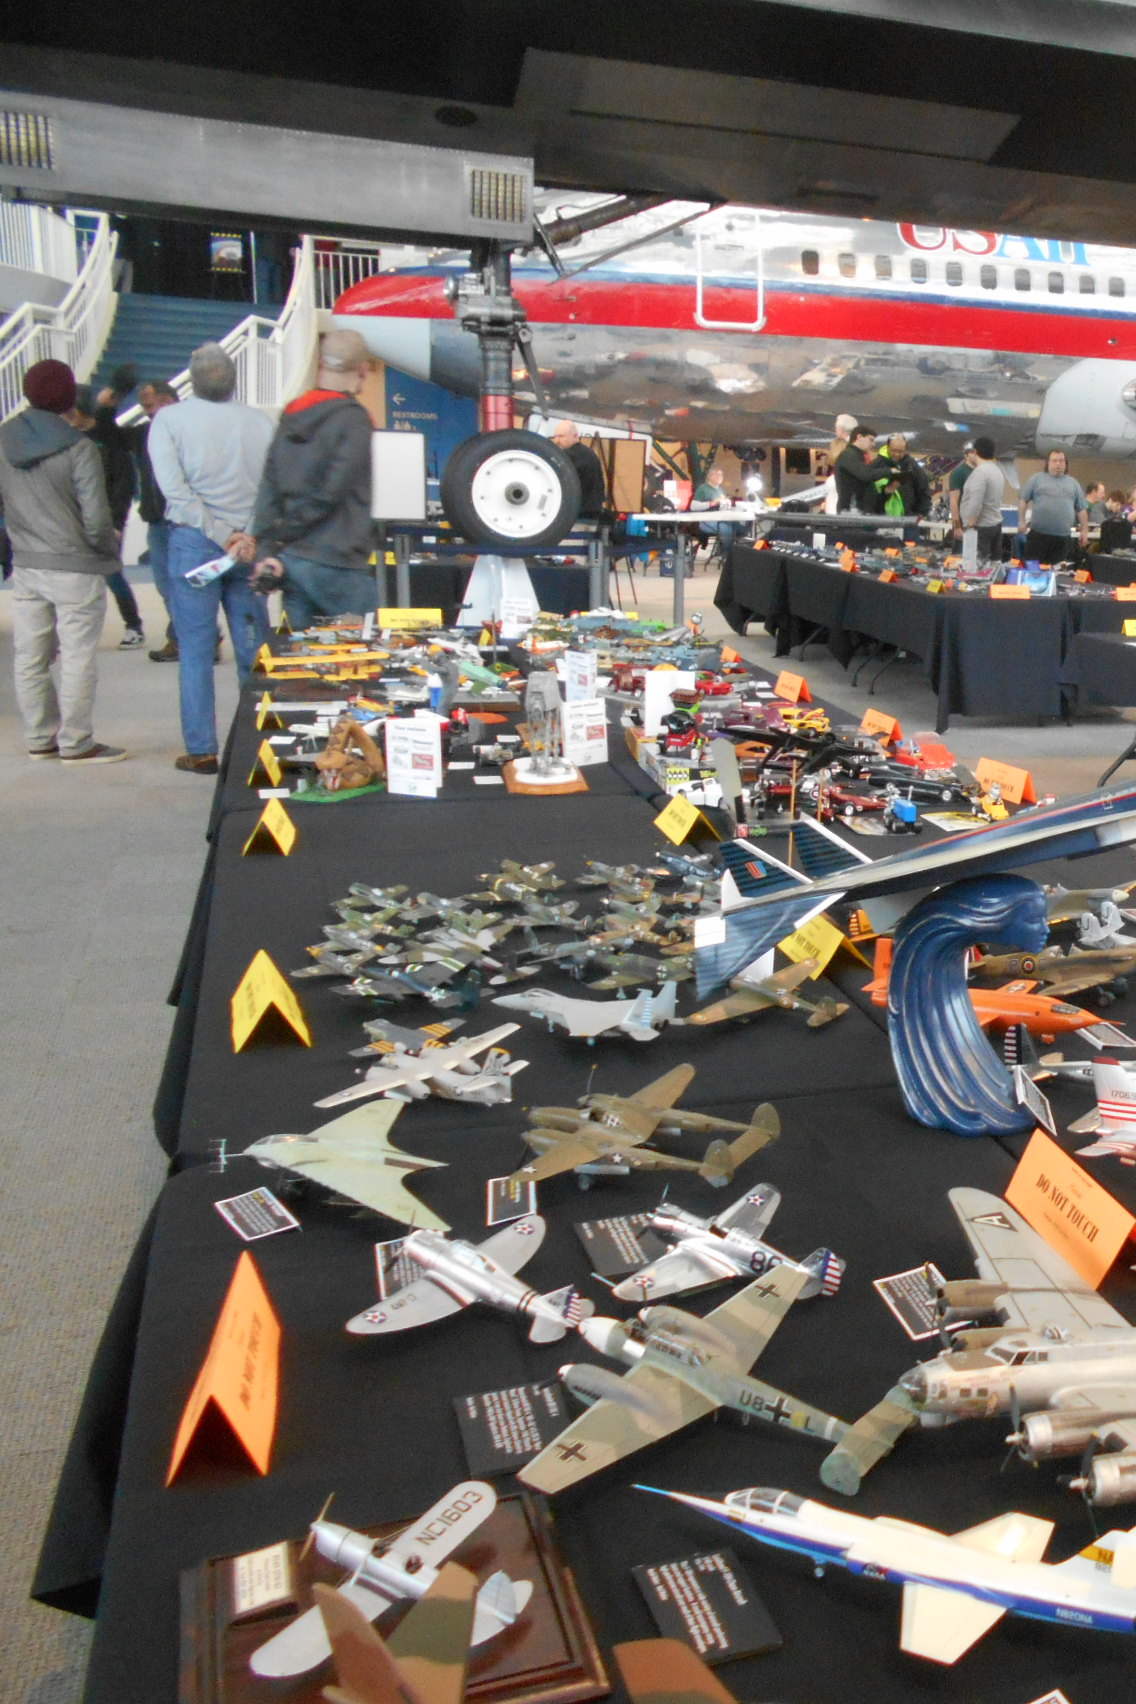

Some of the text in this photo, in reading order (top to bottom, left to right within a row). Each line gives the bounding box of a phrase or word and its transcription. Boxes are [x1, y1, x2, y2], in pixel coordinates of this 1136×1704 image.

[1036, 1173, 1049, 1194] DO
[1048, 1186, 1069, 1212] NOT
[1066, 1204, 1099, 1243] TOUCH
[415, 1491, 484, 1546] NC1603
